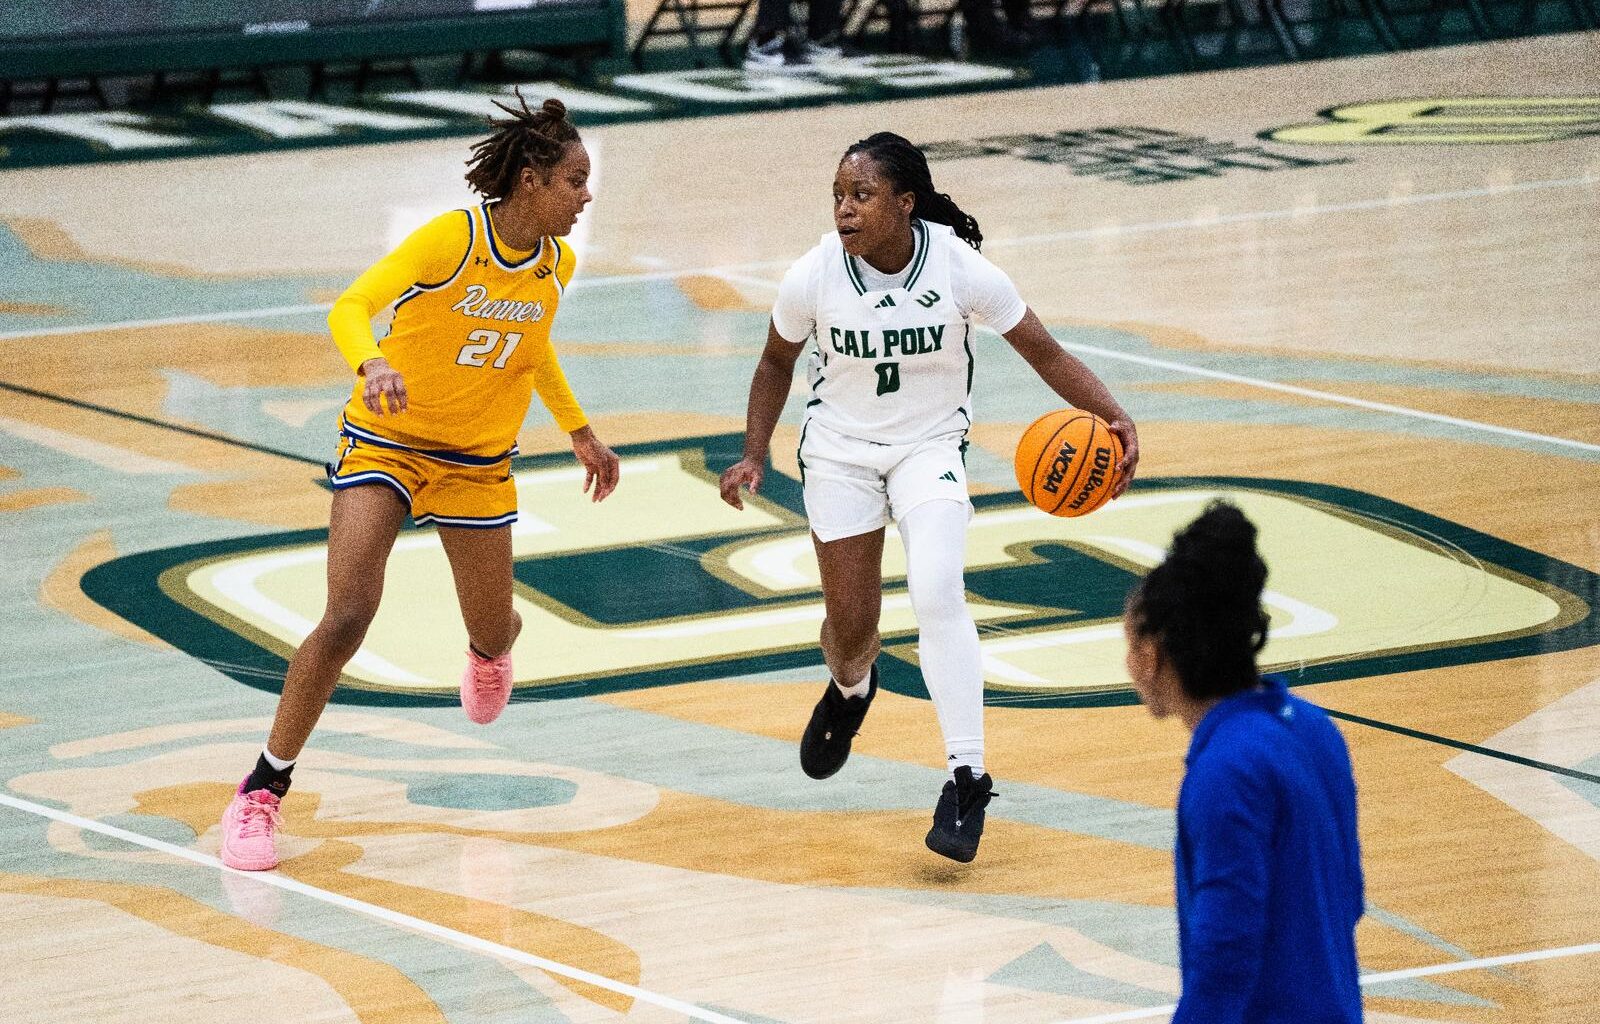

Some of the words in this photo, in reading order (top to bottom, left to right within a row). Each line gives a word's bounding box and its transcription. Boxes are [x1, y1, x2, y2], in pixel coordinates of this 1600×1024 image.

[455, 328, 524, 369] 21
[830, 326, 877, 359] CAL
[882, 324, 946, 358] POLY
[874, 362, 901, 397] 0
[1042, 441, 1078, 494] NCAA
[1068, 447, 1111, 510] Wilson
